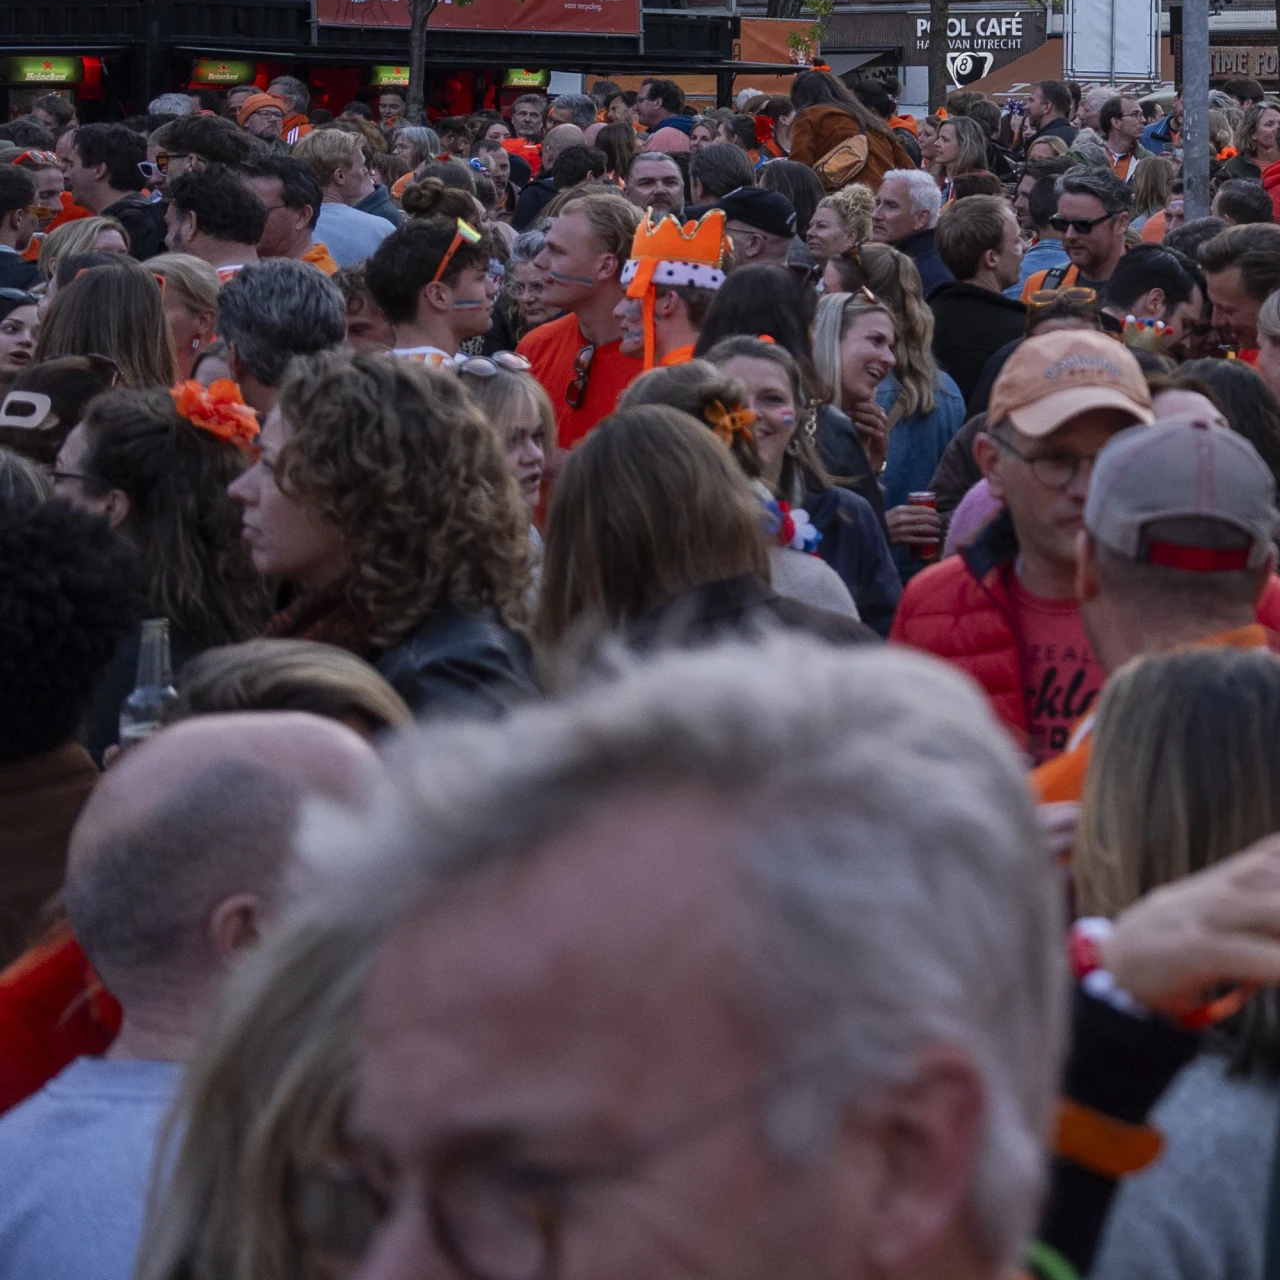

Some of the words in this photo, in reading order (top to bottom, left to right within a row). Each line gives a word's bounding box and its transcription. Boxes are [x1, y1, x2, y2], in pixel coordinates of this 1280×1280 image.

[916, 18, 971, 37] POL
[976, 11, 1023, 36] CAFÉ
[948, 40, 970, 49] VAN
[974, 39, 1022, 49] UTRECHT
[1209, 51, 1248, 75] TIME
[1254, 52, 1278, 76] FO
[25, 72, 68, 81] Heineken
[207, 72, 239, 80] Heineken
[511, 77, 541, 85] Heineken
[1031, 643, 1093, 665] ZEAL
